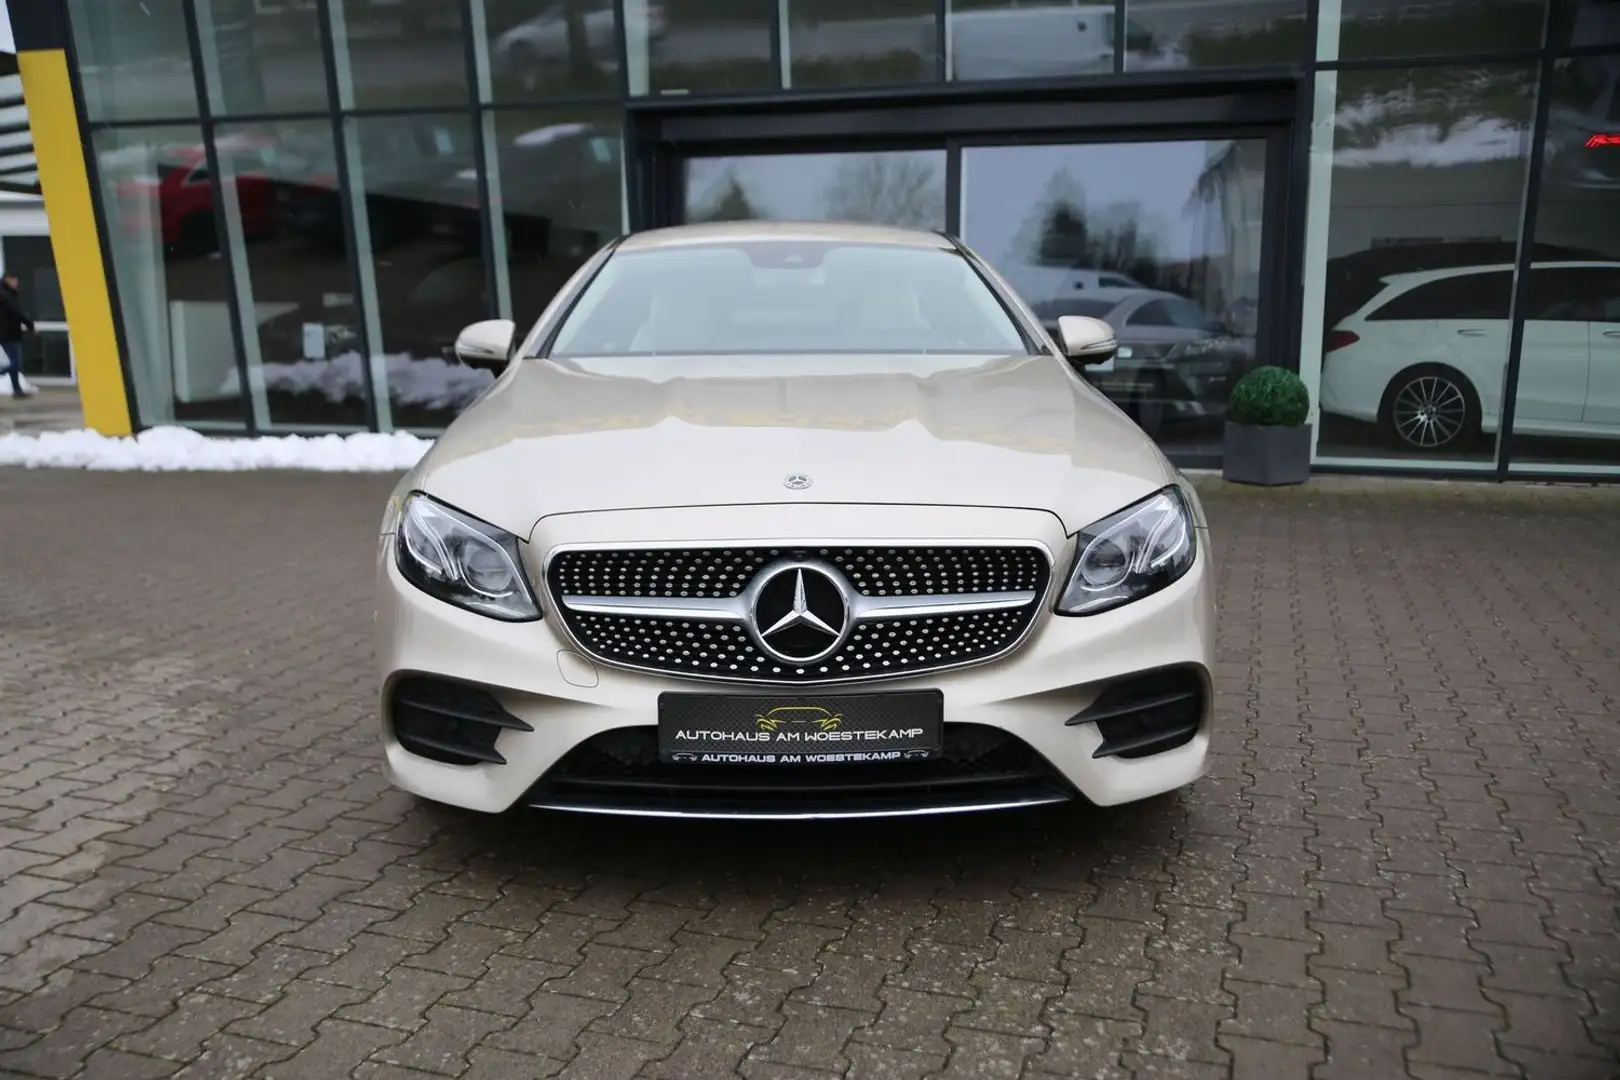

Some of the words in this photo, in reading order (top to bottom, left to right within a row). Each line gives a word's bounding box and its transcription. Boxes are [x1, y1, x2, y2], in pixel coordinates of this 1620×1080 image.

[675, 730, 770, 741] AUTOHAUS
[776, 732, 800, 741] AM
[804, 728, 923, 741] WOESTEKAMP
[701, 754, 776, 763] AUTOHAUS
[780, 755, 801, 763] AM
[805, 751, 901, 762] WOESTEKAMP
